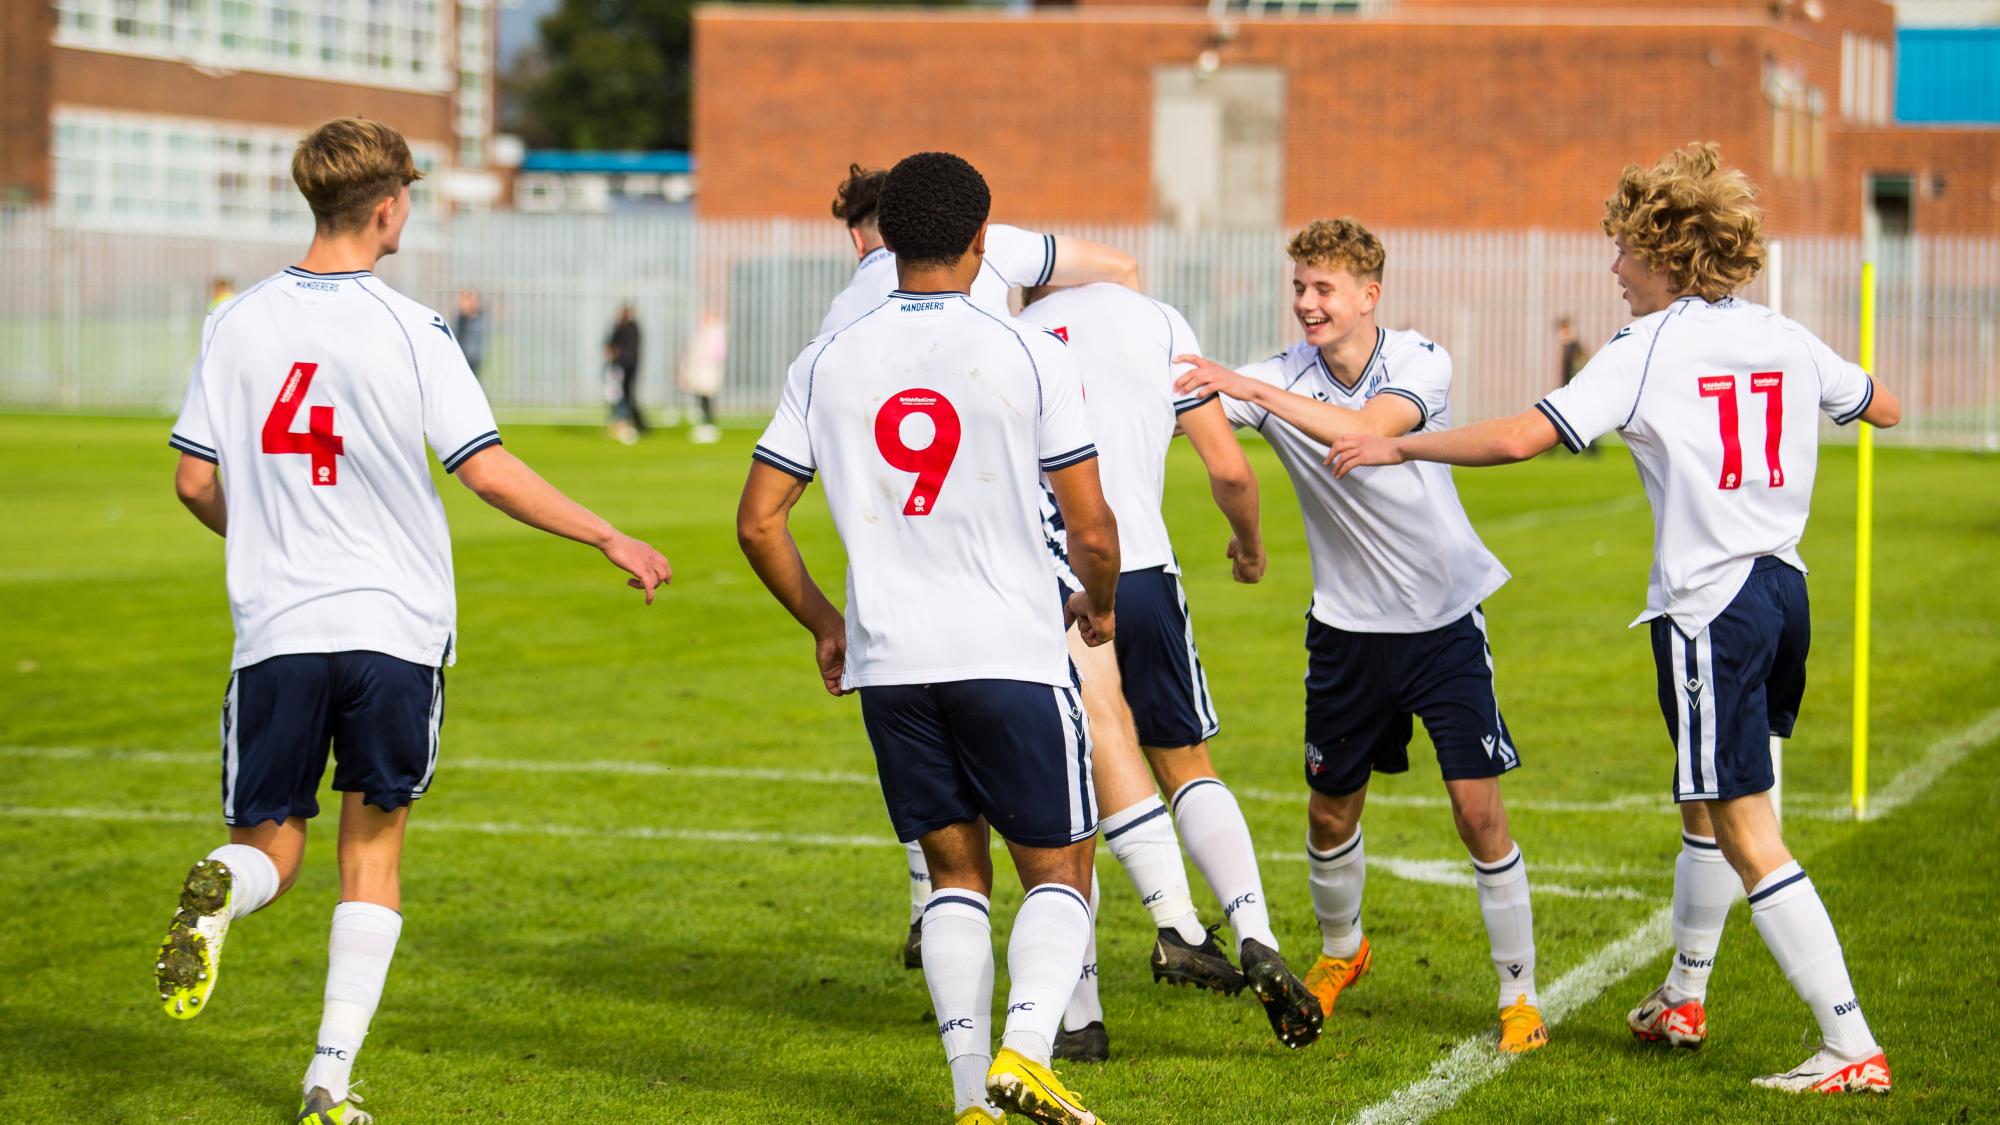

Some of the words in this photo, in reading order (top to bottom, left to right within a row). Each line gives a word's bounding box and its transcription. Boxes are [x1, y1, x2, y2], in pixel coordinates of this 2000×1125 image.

[900, 301, 945, 313] WANDERERS
[262, 361, 345, 486] 4
[875, 388, 961, 516] 9
[1698, 371, 1784, 490] 11
[939, 1018, 974, 1037] WFC
